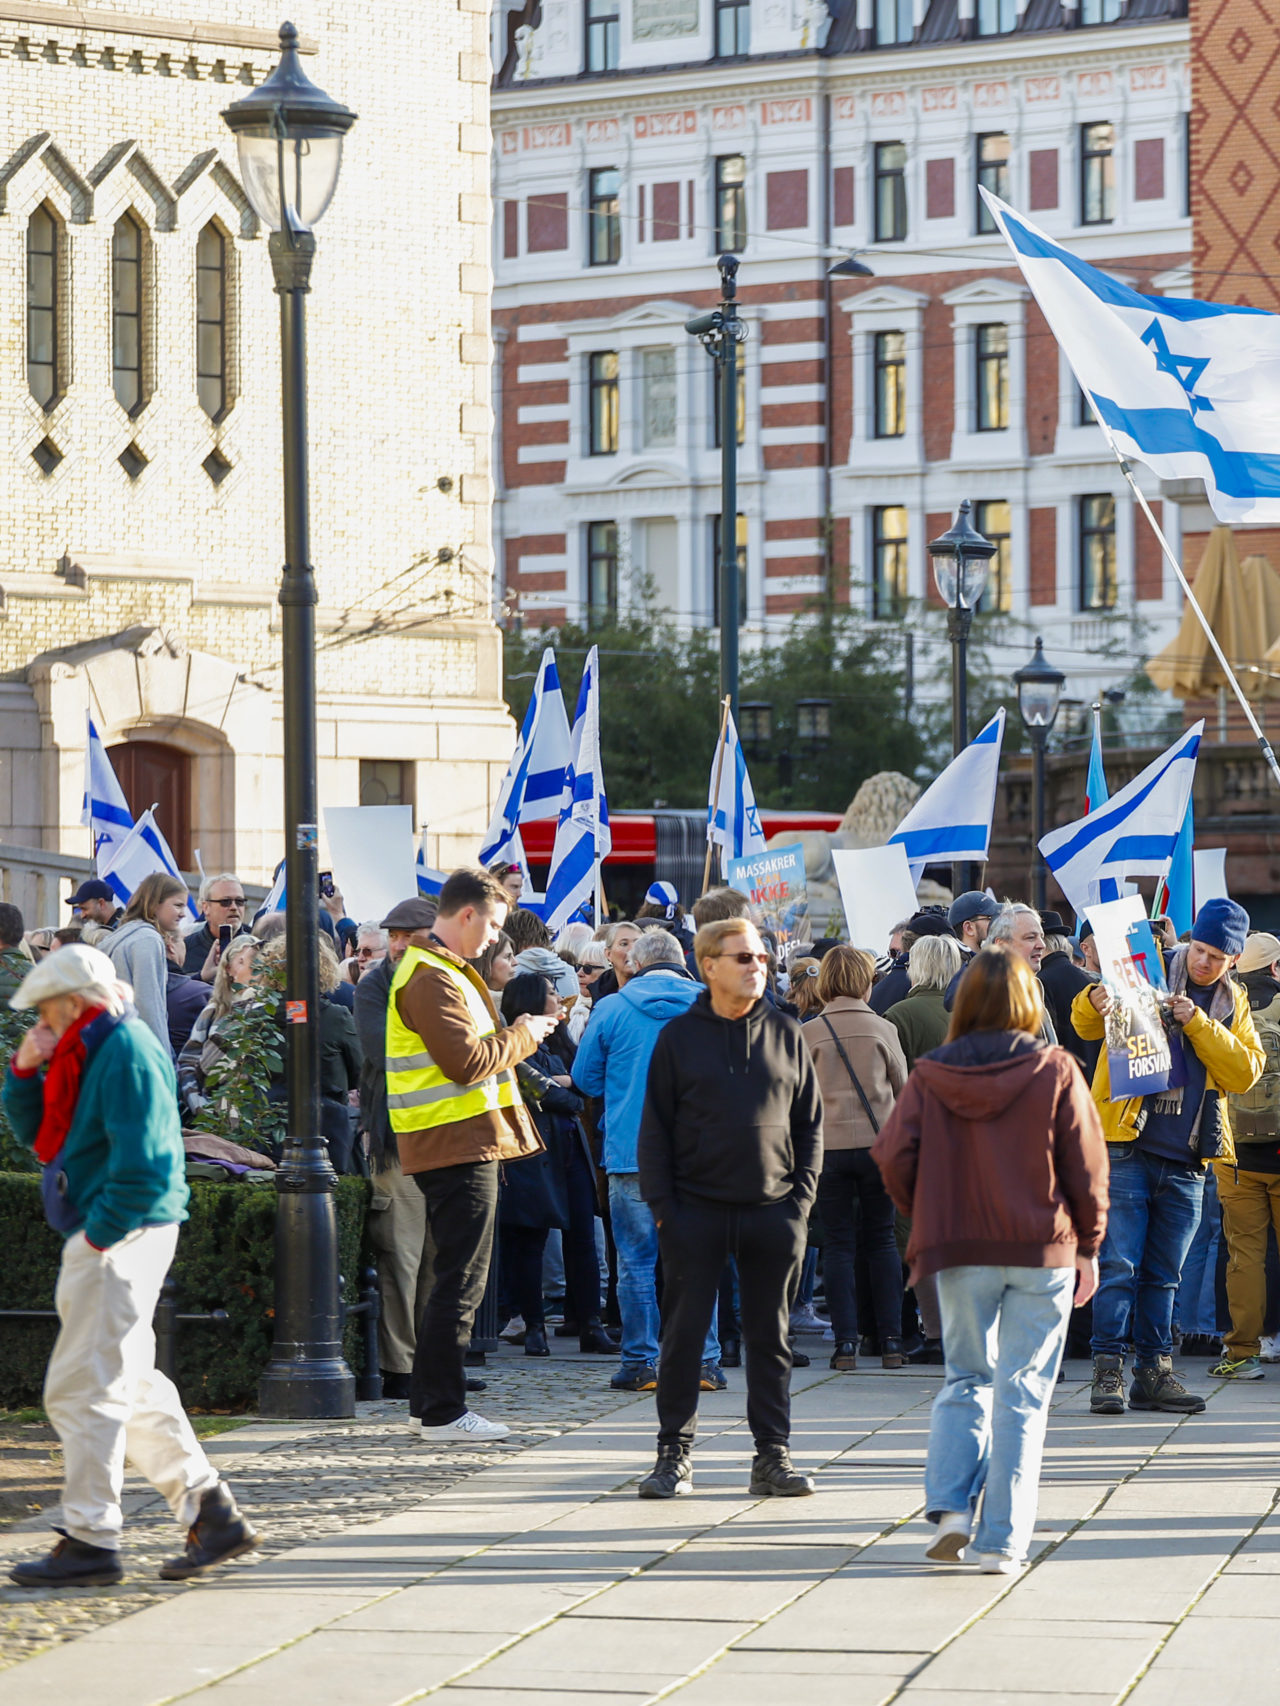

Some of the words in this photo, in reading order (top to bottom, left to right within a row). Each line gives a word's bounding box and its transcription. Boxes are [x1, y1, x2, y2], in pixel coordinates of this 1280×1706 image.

[736, 854, 796, 879] MASSAKRER
[756, 872, 781, 886] KAN
[750, 881, 790, 904] IKKE
